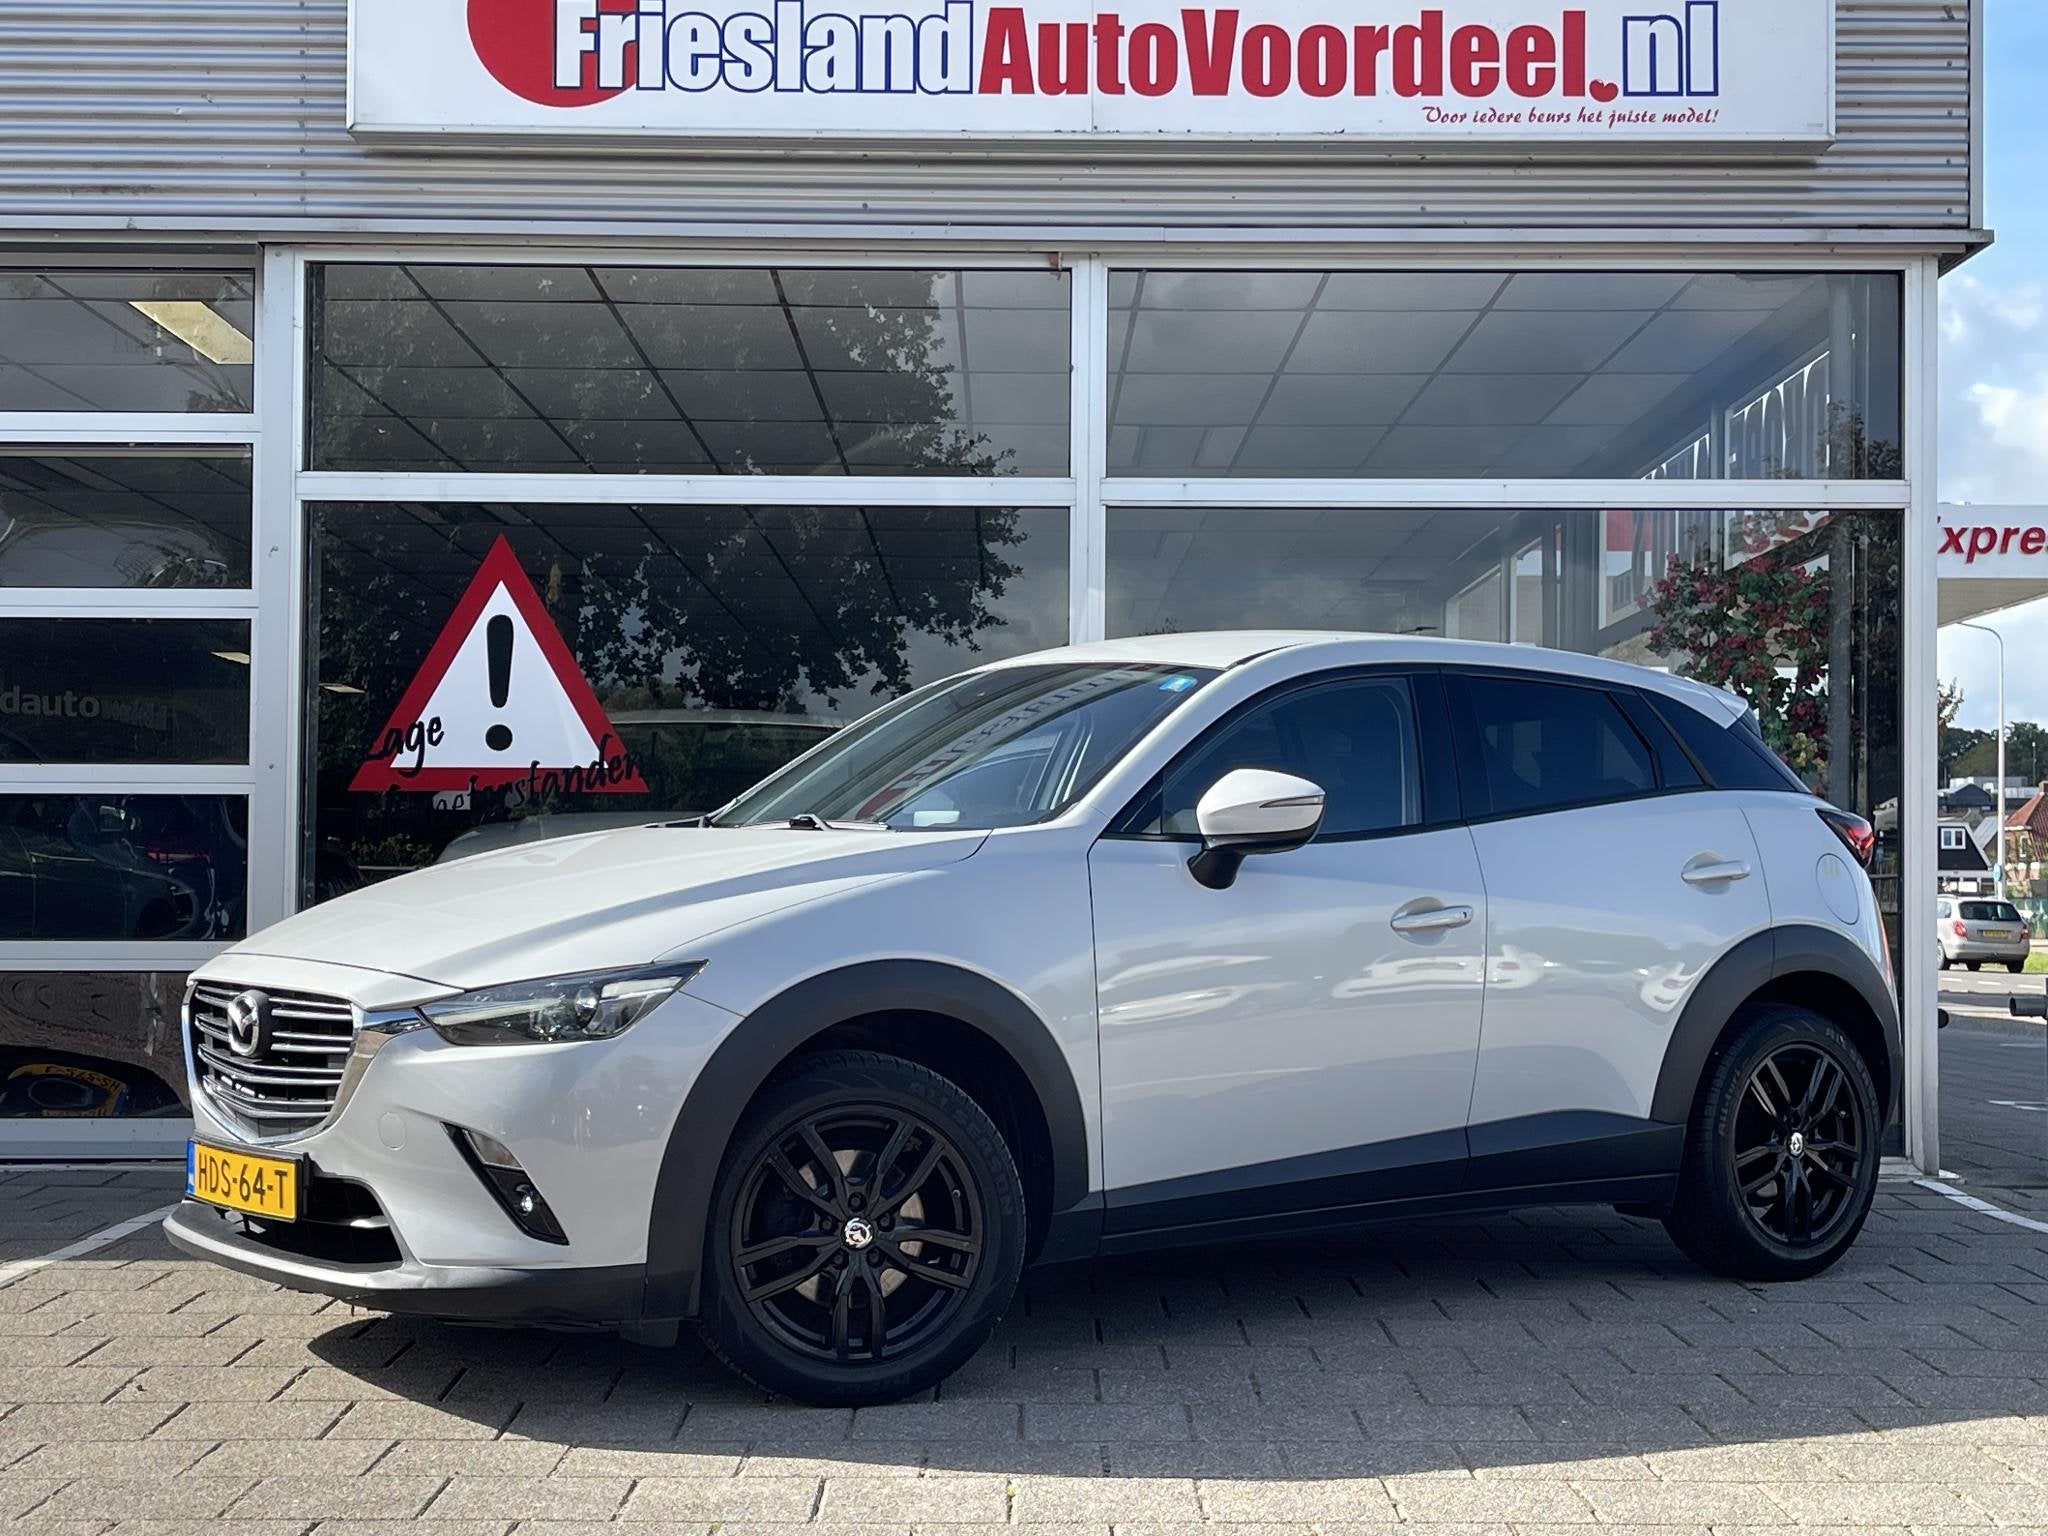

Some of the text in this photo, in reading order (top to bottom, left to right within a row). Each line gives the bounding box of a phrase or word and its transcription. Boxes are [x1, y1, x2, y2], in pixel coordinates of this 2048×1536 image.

[1421, 106, 1720, 130] Voor iedere beurs het juiste model!
[1937, 516, 2048, 564] xpre
[198, 1151, 288, 1209] HDS-64-T
